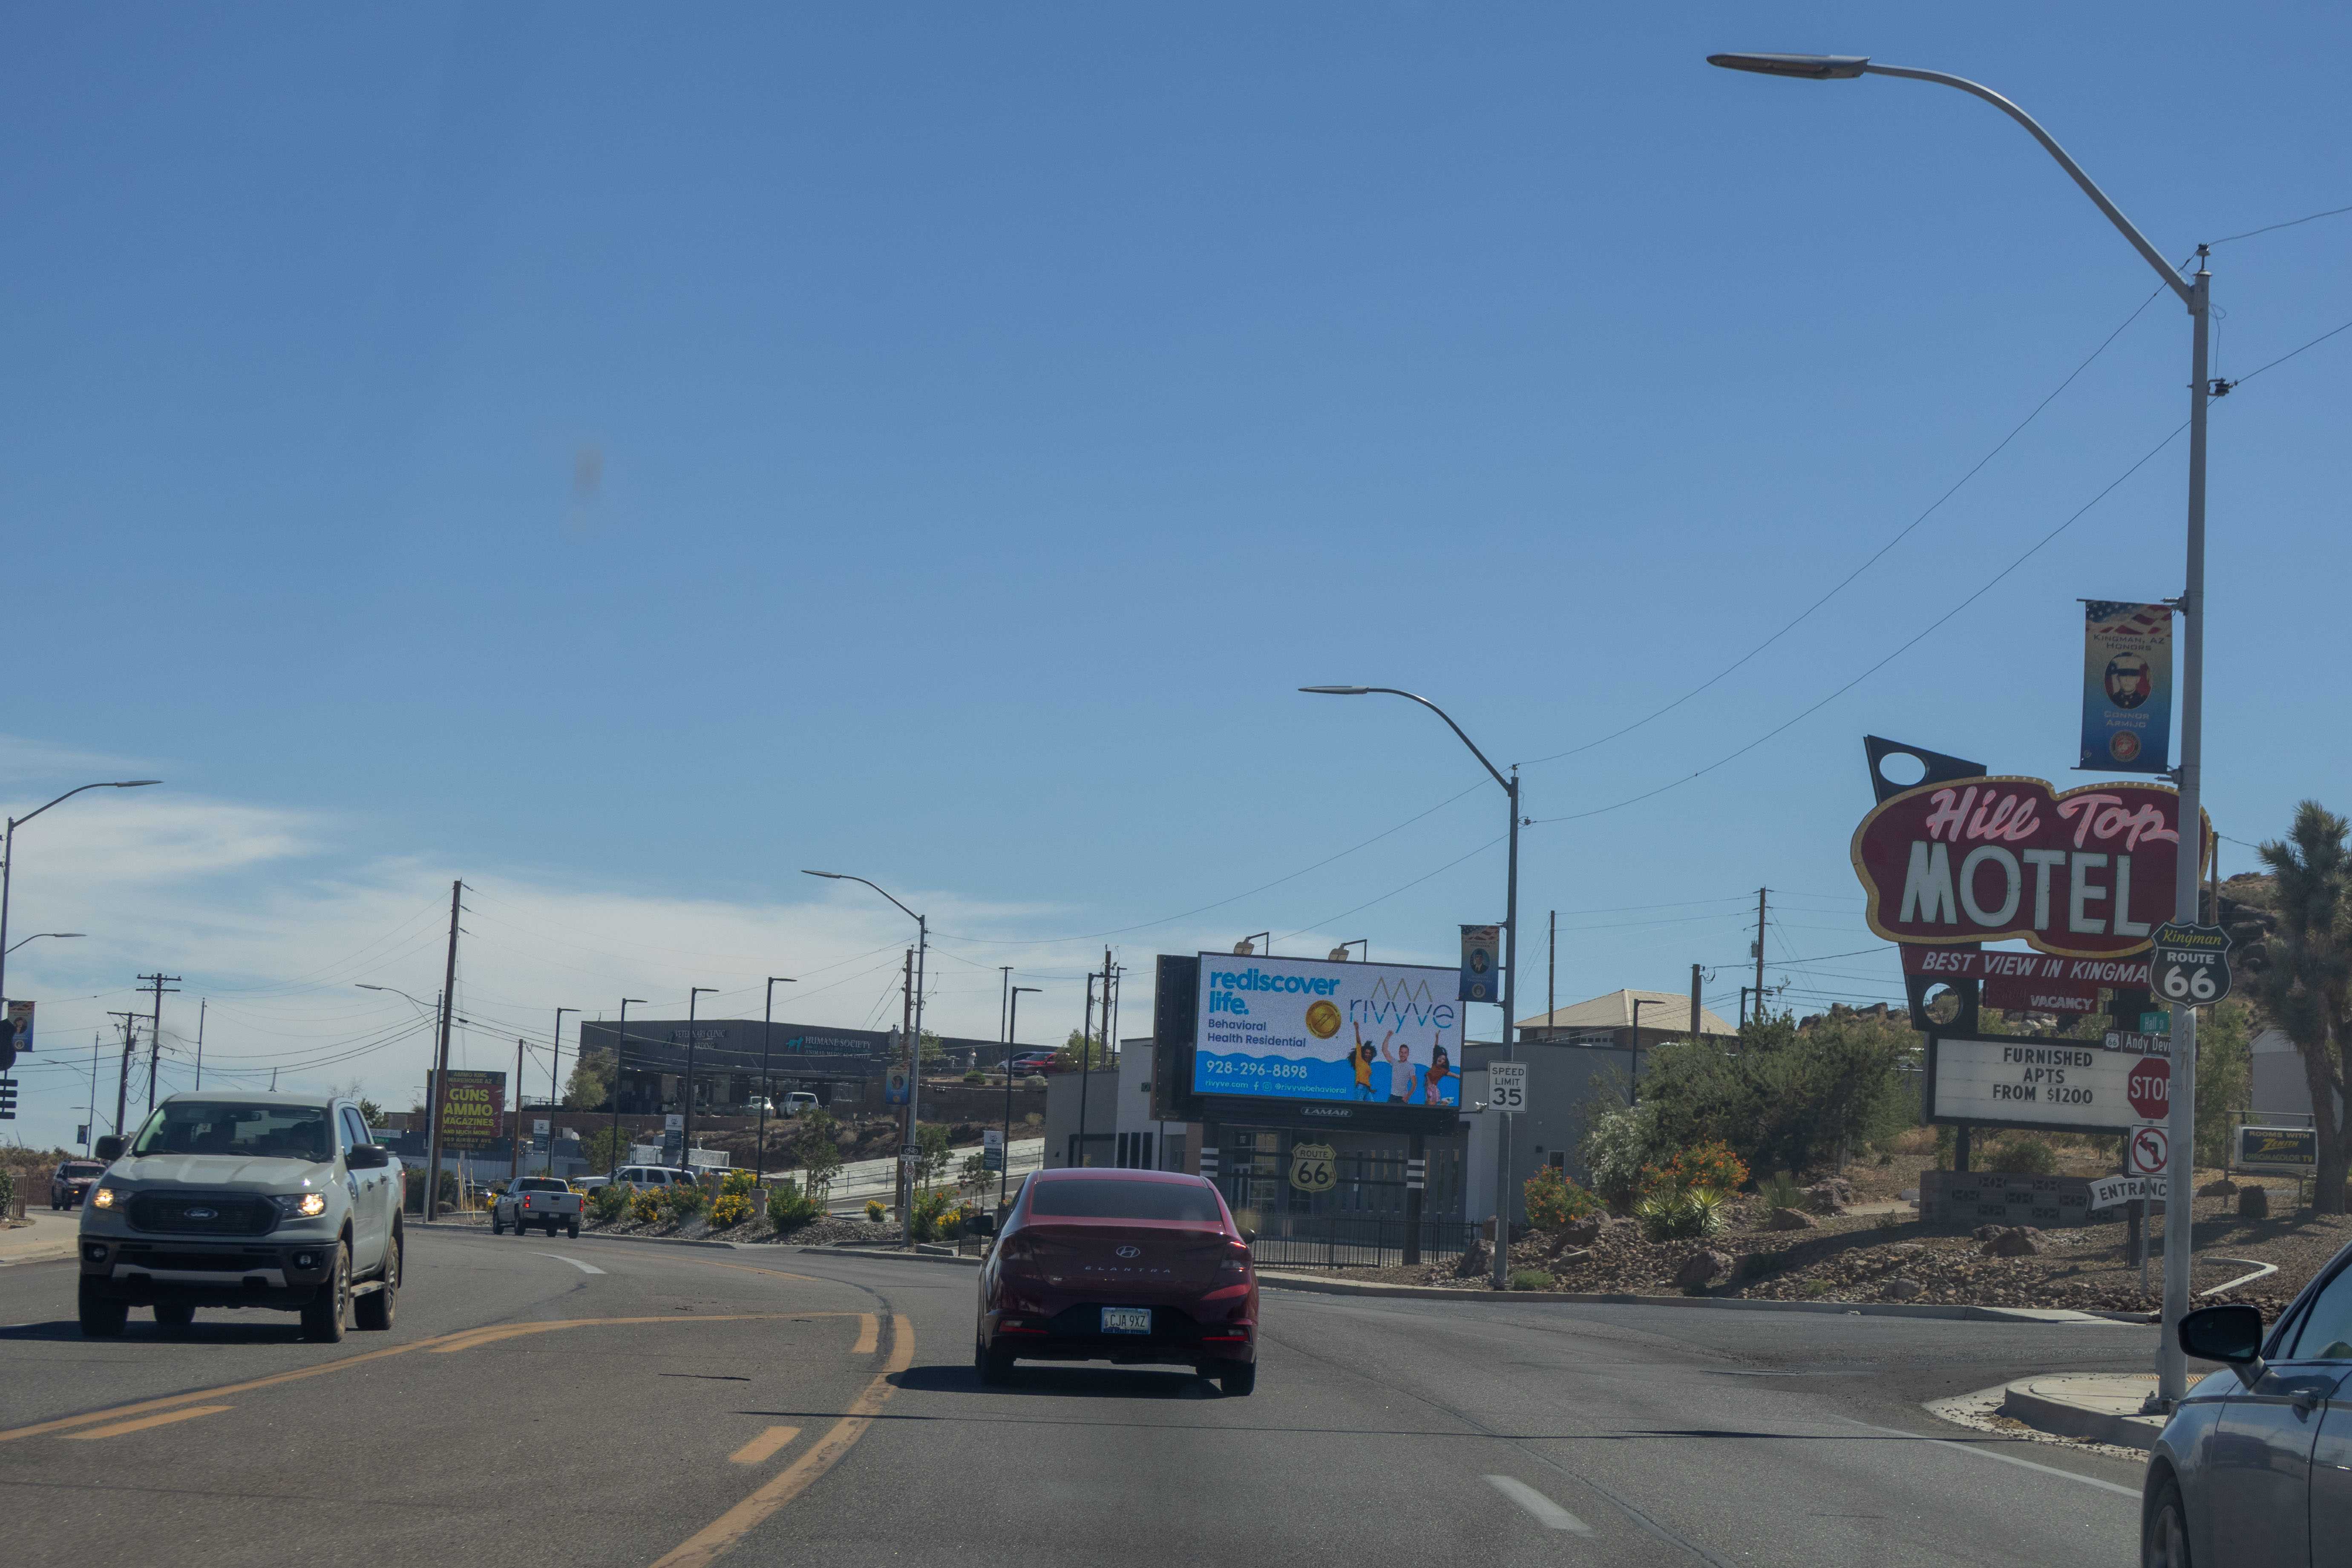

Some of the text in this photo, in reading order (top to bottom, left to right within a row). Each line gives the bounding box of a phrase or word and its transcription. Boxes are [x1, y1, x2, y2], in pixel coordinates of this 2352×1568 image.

[1926, 786, 2179, 852] Hill Top
[1899, 840, 2151, 937] MOTEL
[2162, 929, 2222, 947] Kingman
[2167, 952, 2215, 964] ROUTE
[1922, 952, 2150, 983] BEST VIEW IN KINGMA
[1210, 968, 1340, 995] rediscover
[2164, 965, 2216, 999] 66
[1209, 991, 1249, 1015] life.
[2030, 995, 2094, 1010] VACANCY
[1350, 999, 1454, 1033] rivyve
[2145, 1016, 2157, 1030] Hall
[1208, 1019, 1266, 1031] Behavioral
[805, 1036, 871, 1049] HUMANE SOCIETY
[1208, 1033, 1306, 1047] Health Residential
[2126, 1034, 2148, 1053] Andy
[2152, 1036, 2171, 1052] Devi
[2004, 1047, 2093, 1067] FURNISHED
[1206, 1060, 1307, 1079] 928-296-8898
[1492, 1067, 1524, 1076] SPEED
[2024, 1067, 2065, 1084] APTS
[1205, 1080, 1249, 1089] rivyve.com
[1495, 1078, 1520, 1086] LIMIT
[449, 1088, 489, 1102] GUNS
[1492, 1087, 1522, 1106] 35
[1993, 1084, 2036, 1101] FROM
[443, 1102, 493, 1116] AMMO
[443, 1117, 494, 1126] MAGAZINES
[1298, 1161, 1329, 1185] 66
[2099, 1182, 2167, 1201] ENTRANC
[1110, 1314, 1145, 1327] CJA 9XZ
